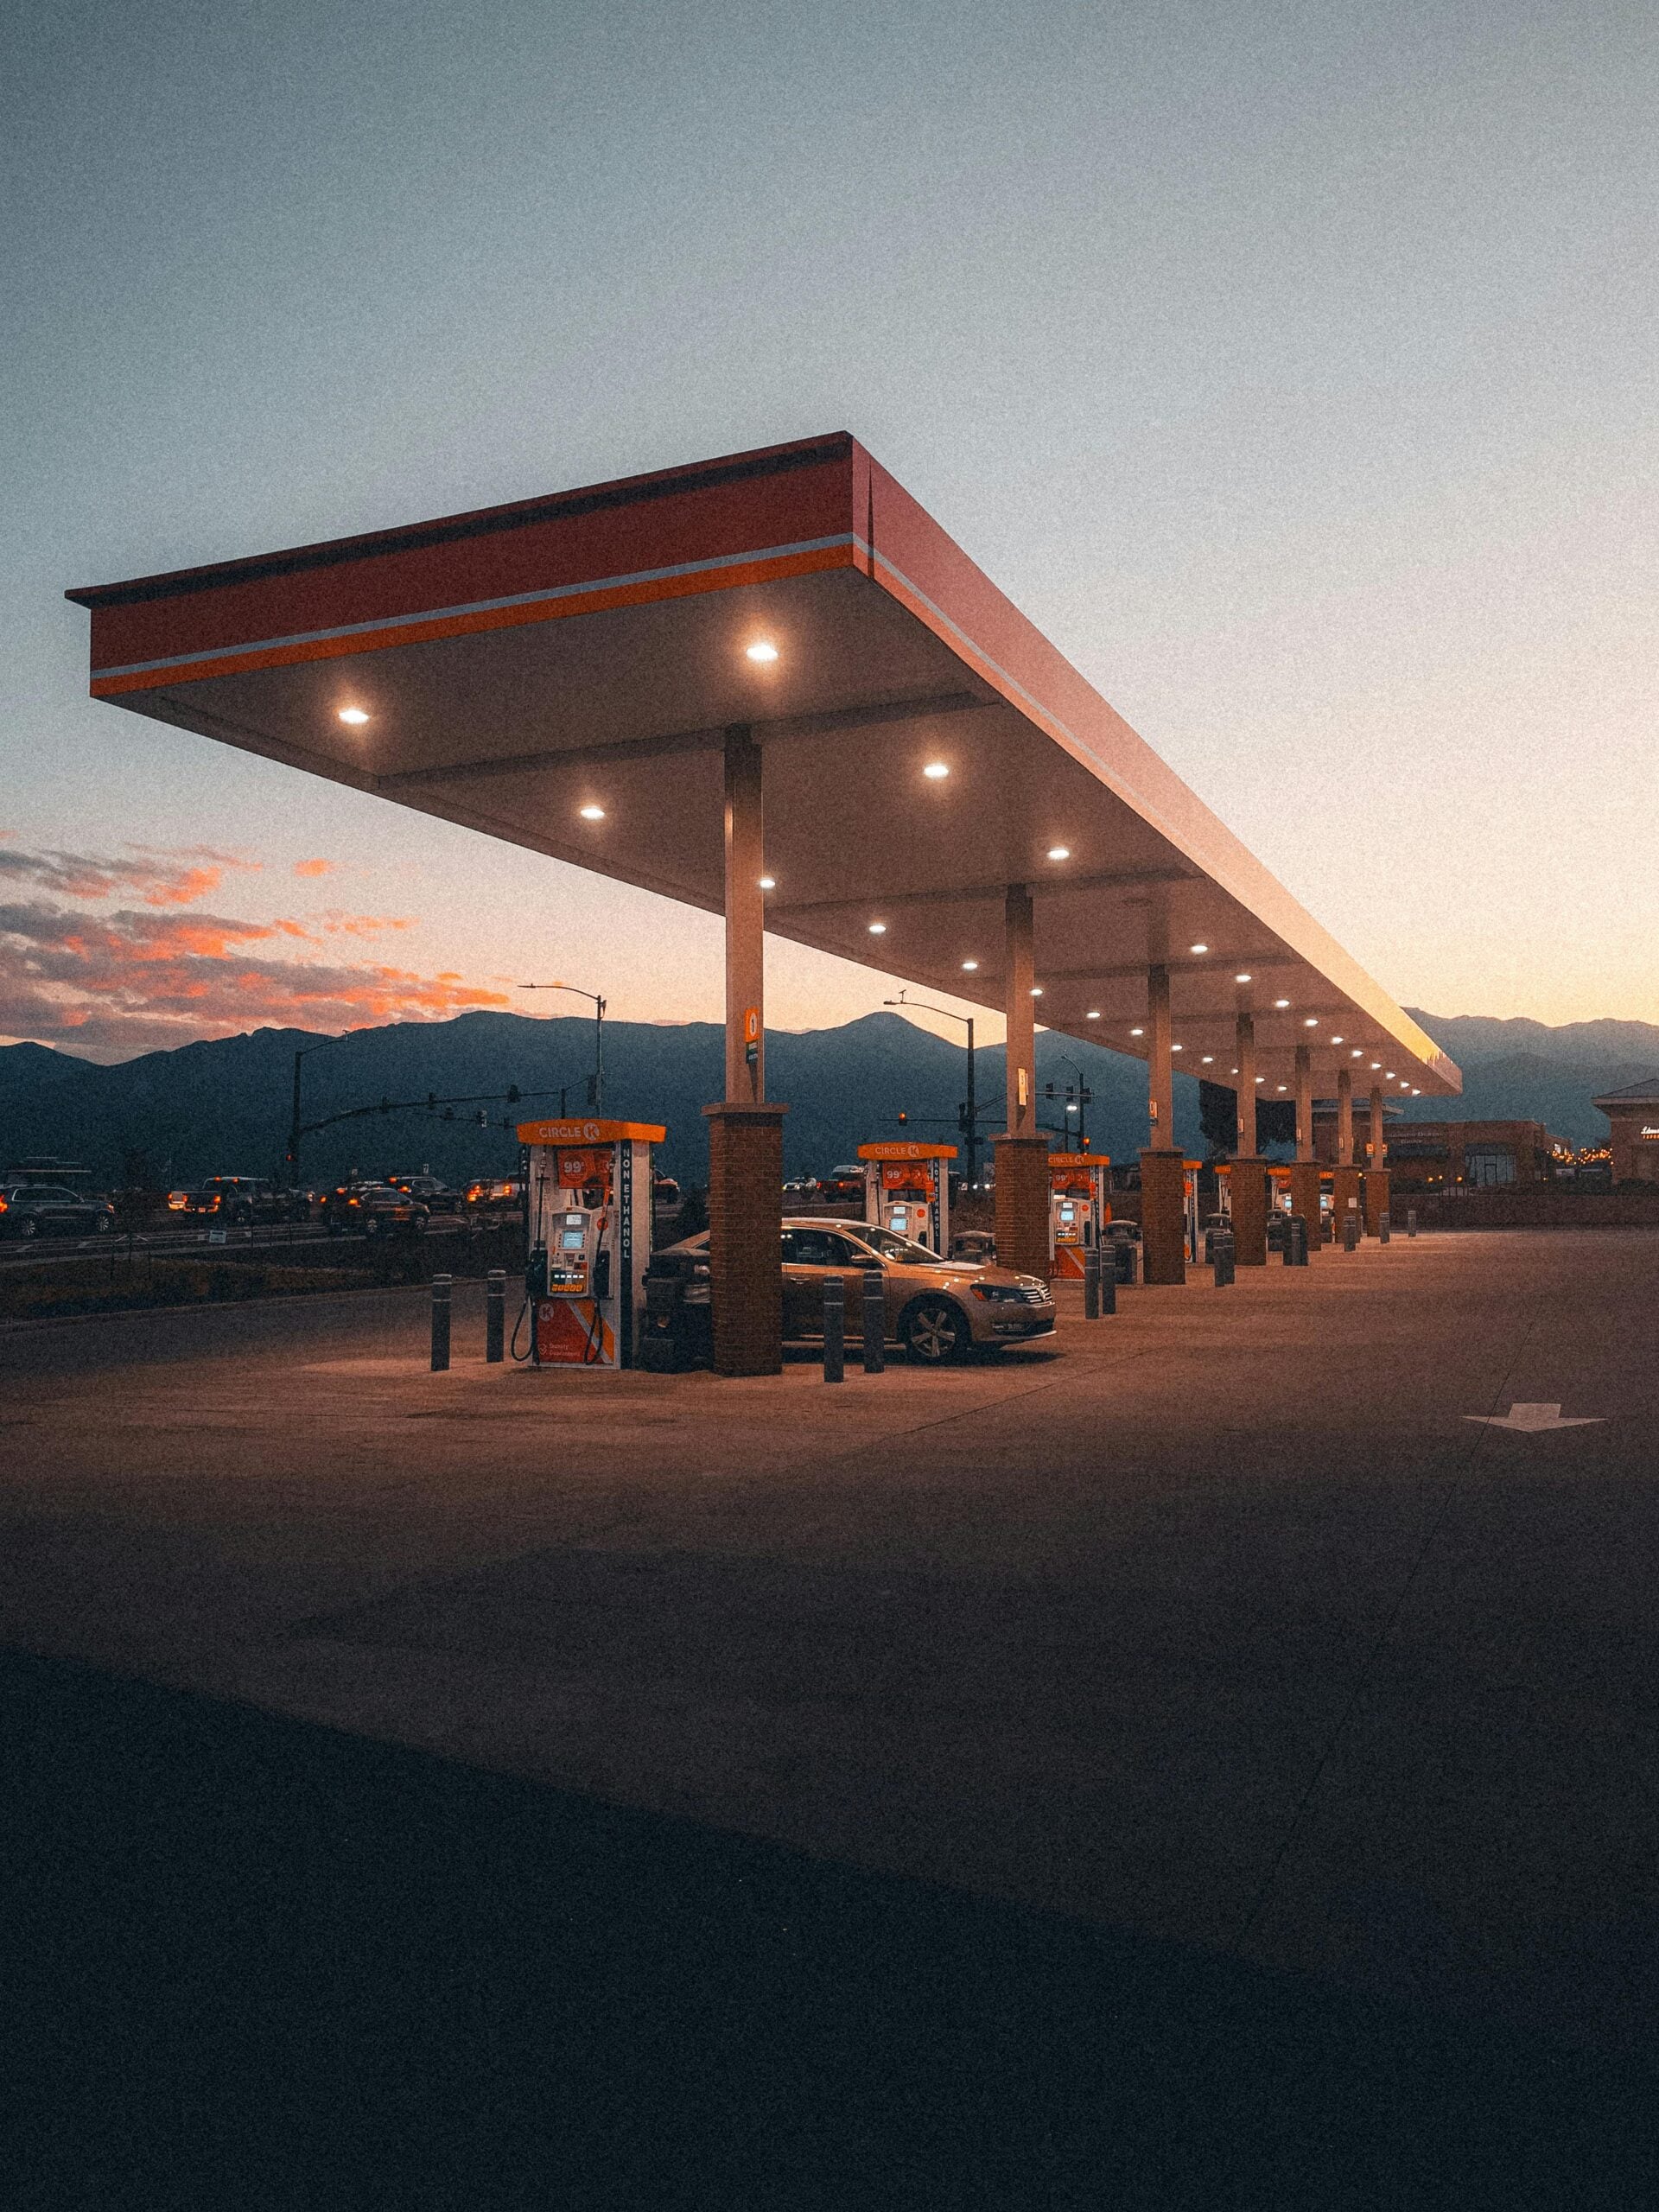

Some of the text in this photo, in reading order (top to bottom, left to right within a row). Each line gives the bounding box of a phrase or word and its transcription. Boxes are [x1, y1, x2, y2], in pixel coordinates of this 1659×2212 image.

[539, 1122, 600, 1141] CIRCLE K
[875, 1145, 919, 1157] CIRCLE K
[539, 1303, 554, 1322] K
